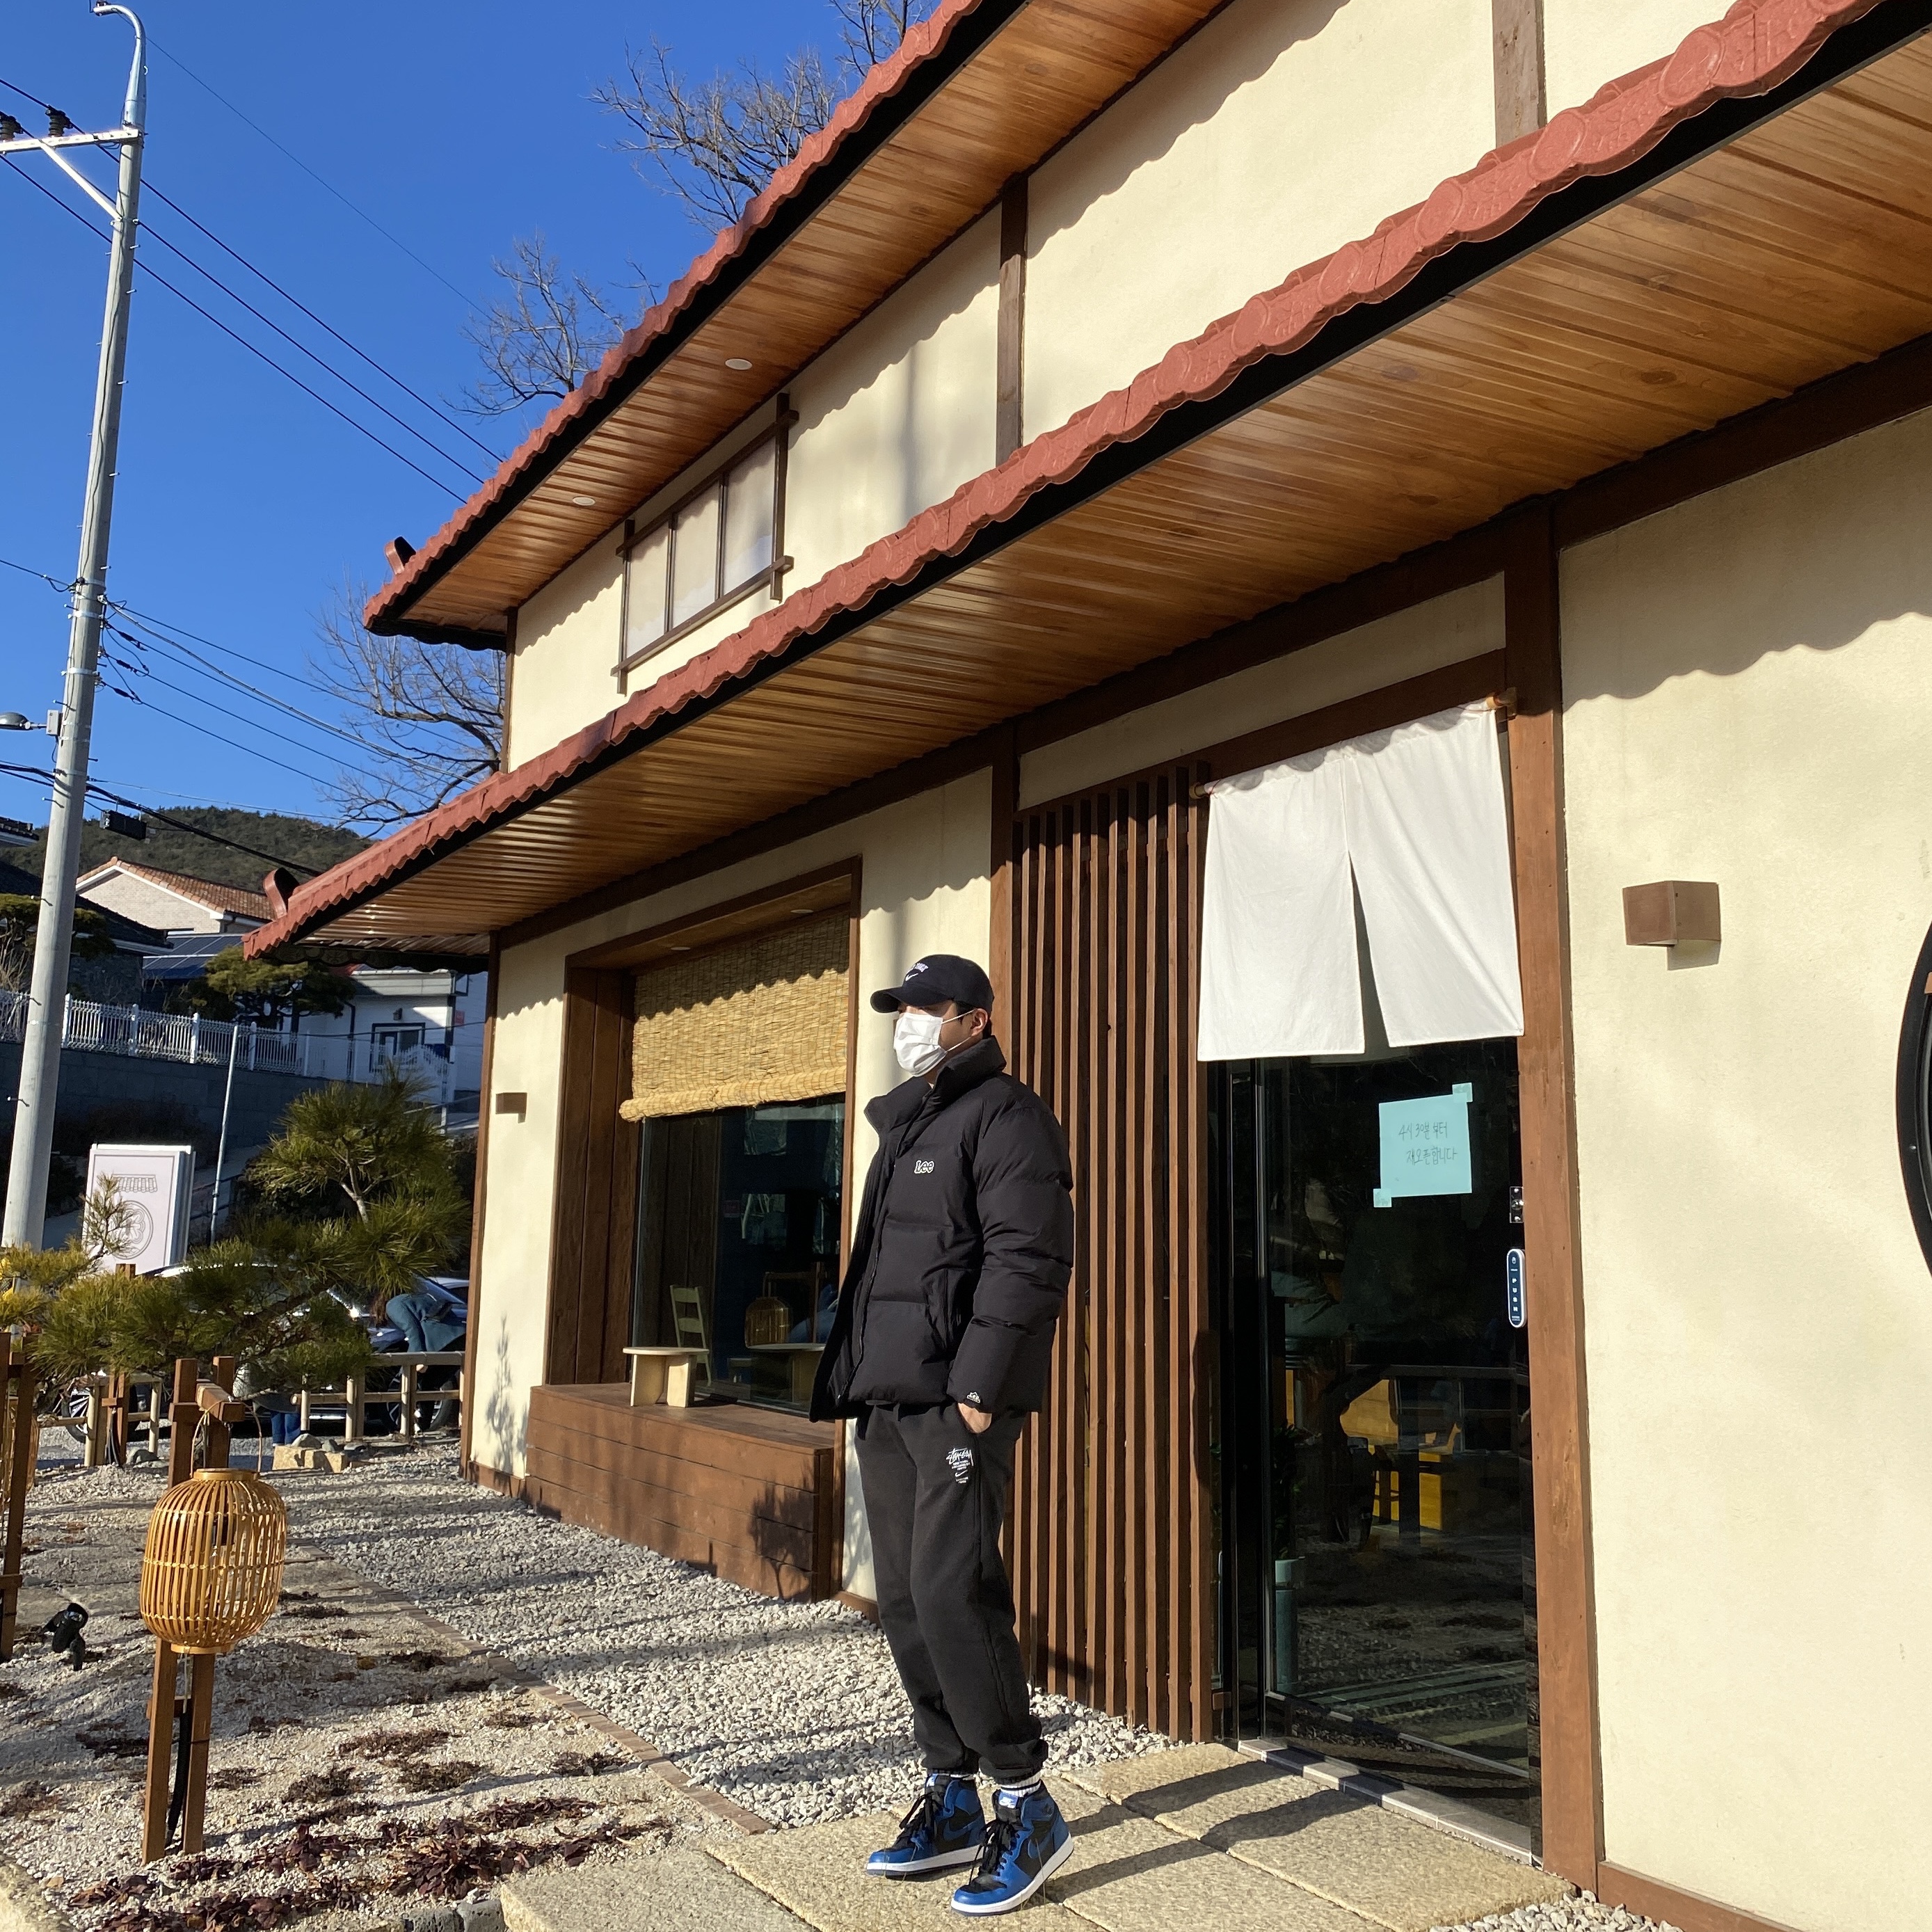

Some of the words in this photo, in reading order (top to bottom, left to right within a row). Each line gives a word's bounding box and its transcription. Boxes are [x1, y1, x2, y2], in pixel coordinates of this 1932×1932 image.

[1398, 1123, 1412, 1141] 4시
[1433, 1121, 1448, 1139] 부터
[1406, 1146, 1458, 1166] 재오픈합니다
